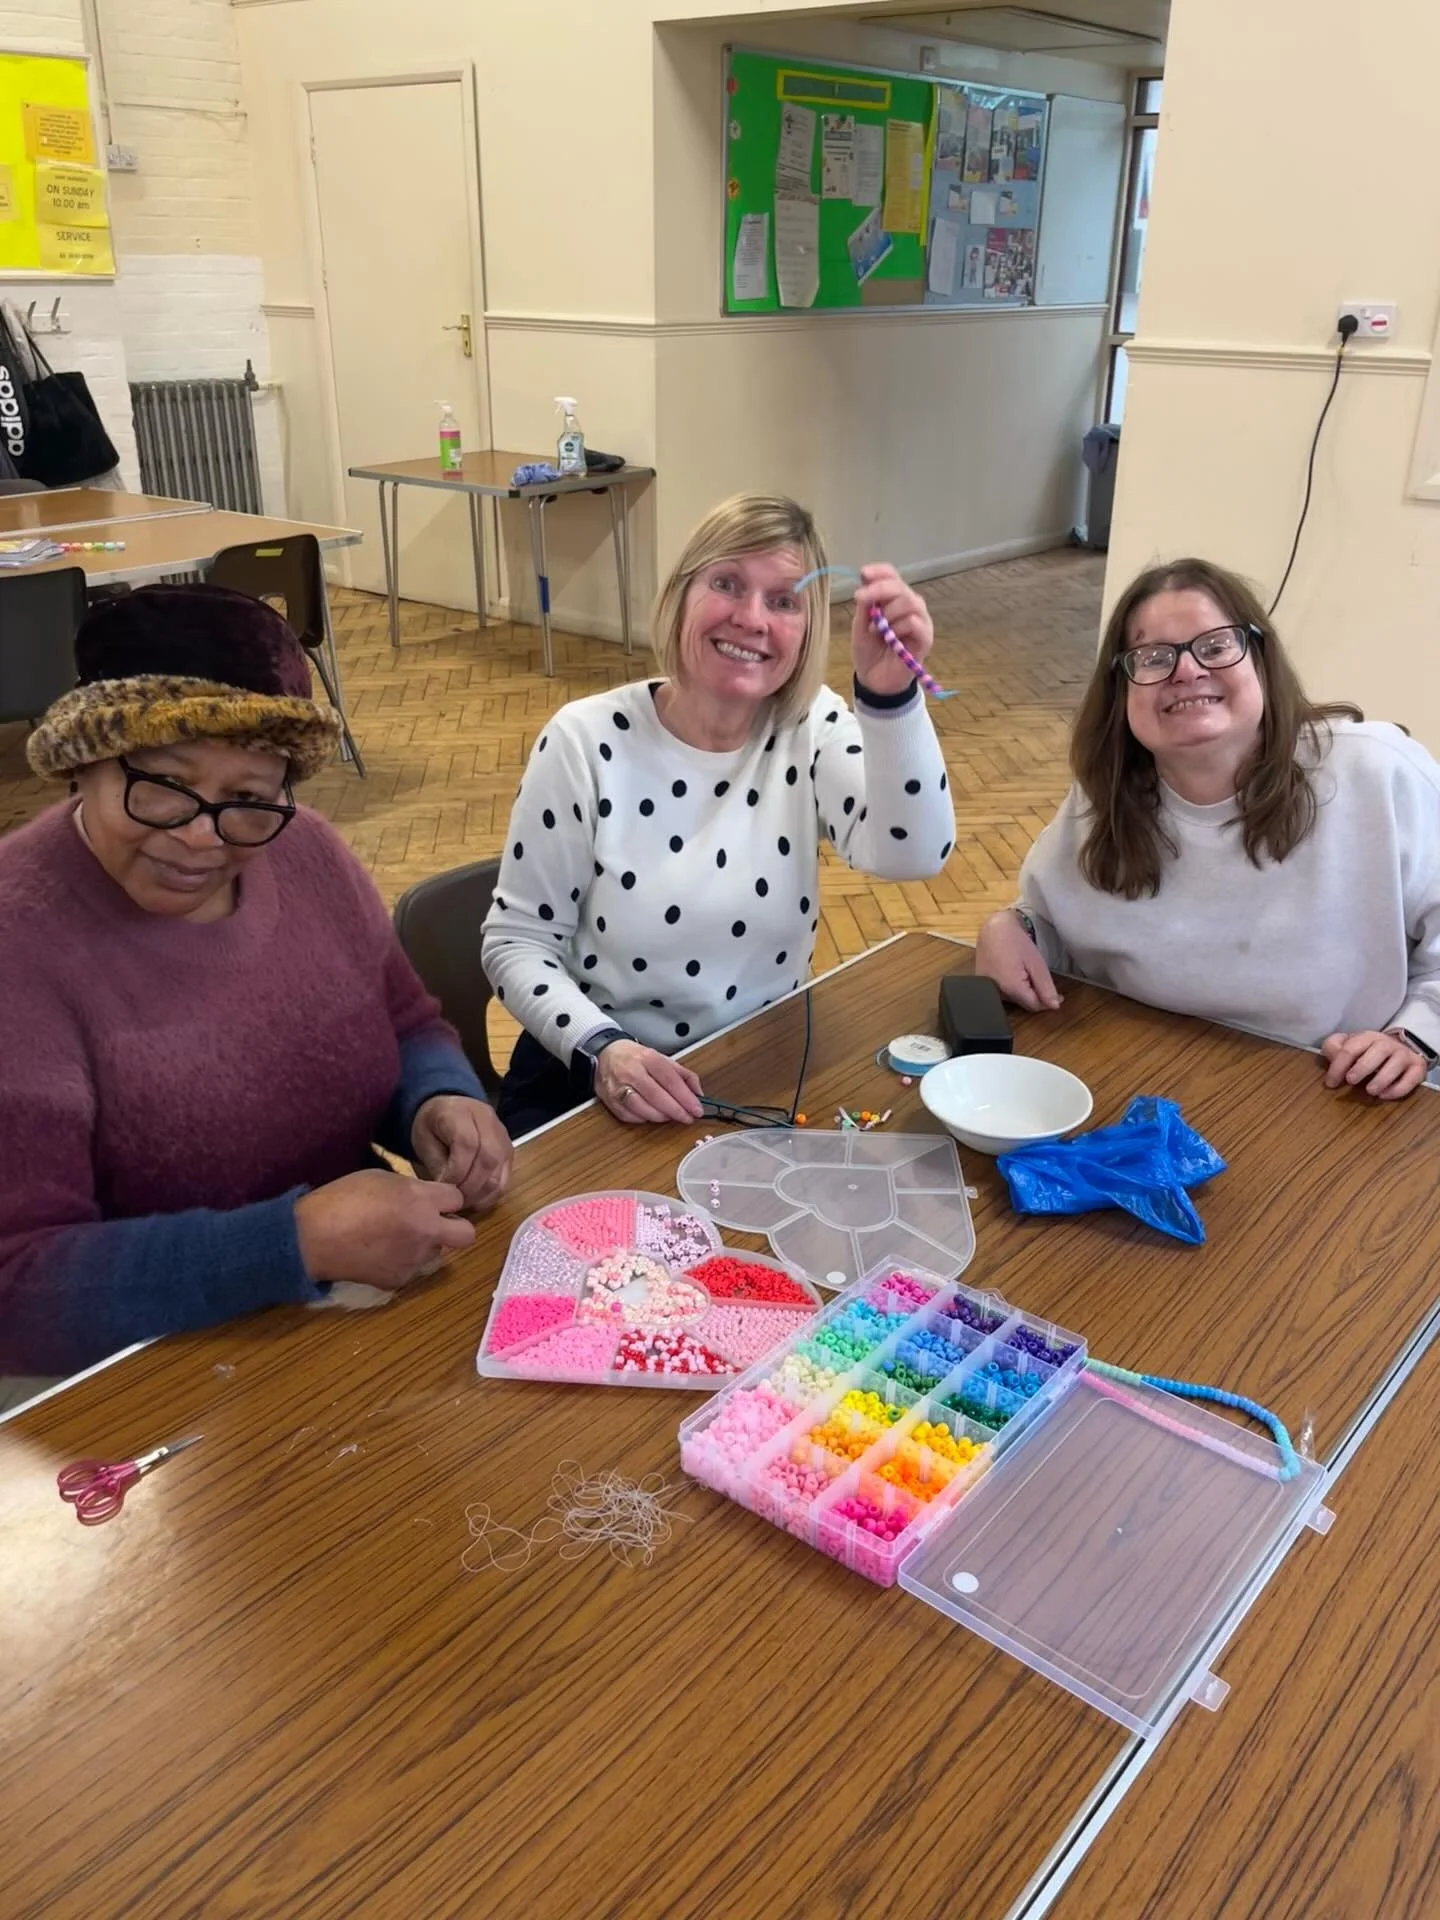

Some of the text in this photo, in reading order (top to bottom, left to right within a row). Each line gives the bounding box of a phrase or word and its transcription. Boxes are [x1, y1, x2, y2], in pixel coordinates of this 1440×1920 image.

[46, 184, 94, 198] ON SUNDAY
[56, 231, 92, 242] SERVICE
